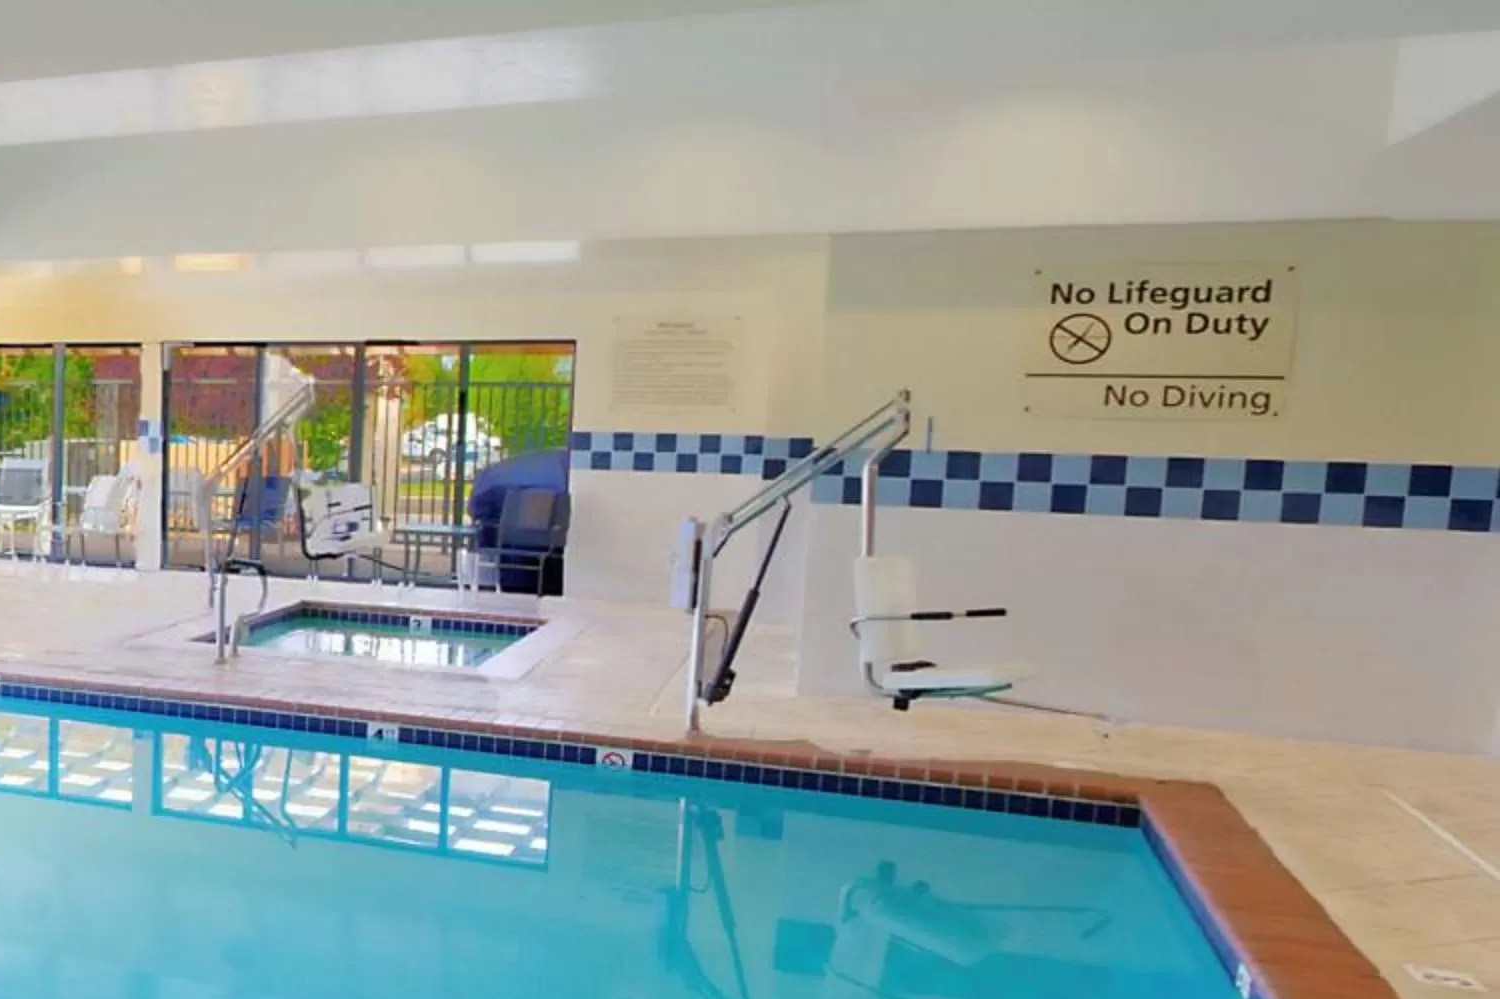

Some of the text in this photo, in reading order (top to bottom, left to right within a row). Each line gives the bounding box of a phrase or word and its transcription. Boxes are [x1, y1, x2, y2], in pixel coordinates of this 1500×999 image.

[1049, 279, 1273, 311] No Lifeguard
[1123, 311, 1270, 341] On Duty
[1103, 383, 1272, 416] No Diving
